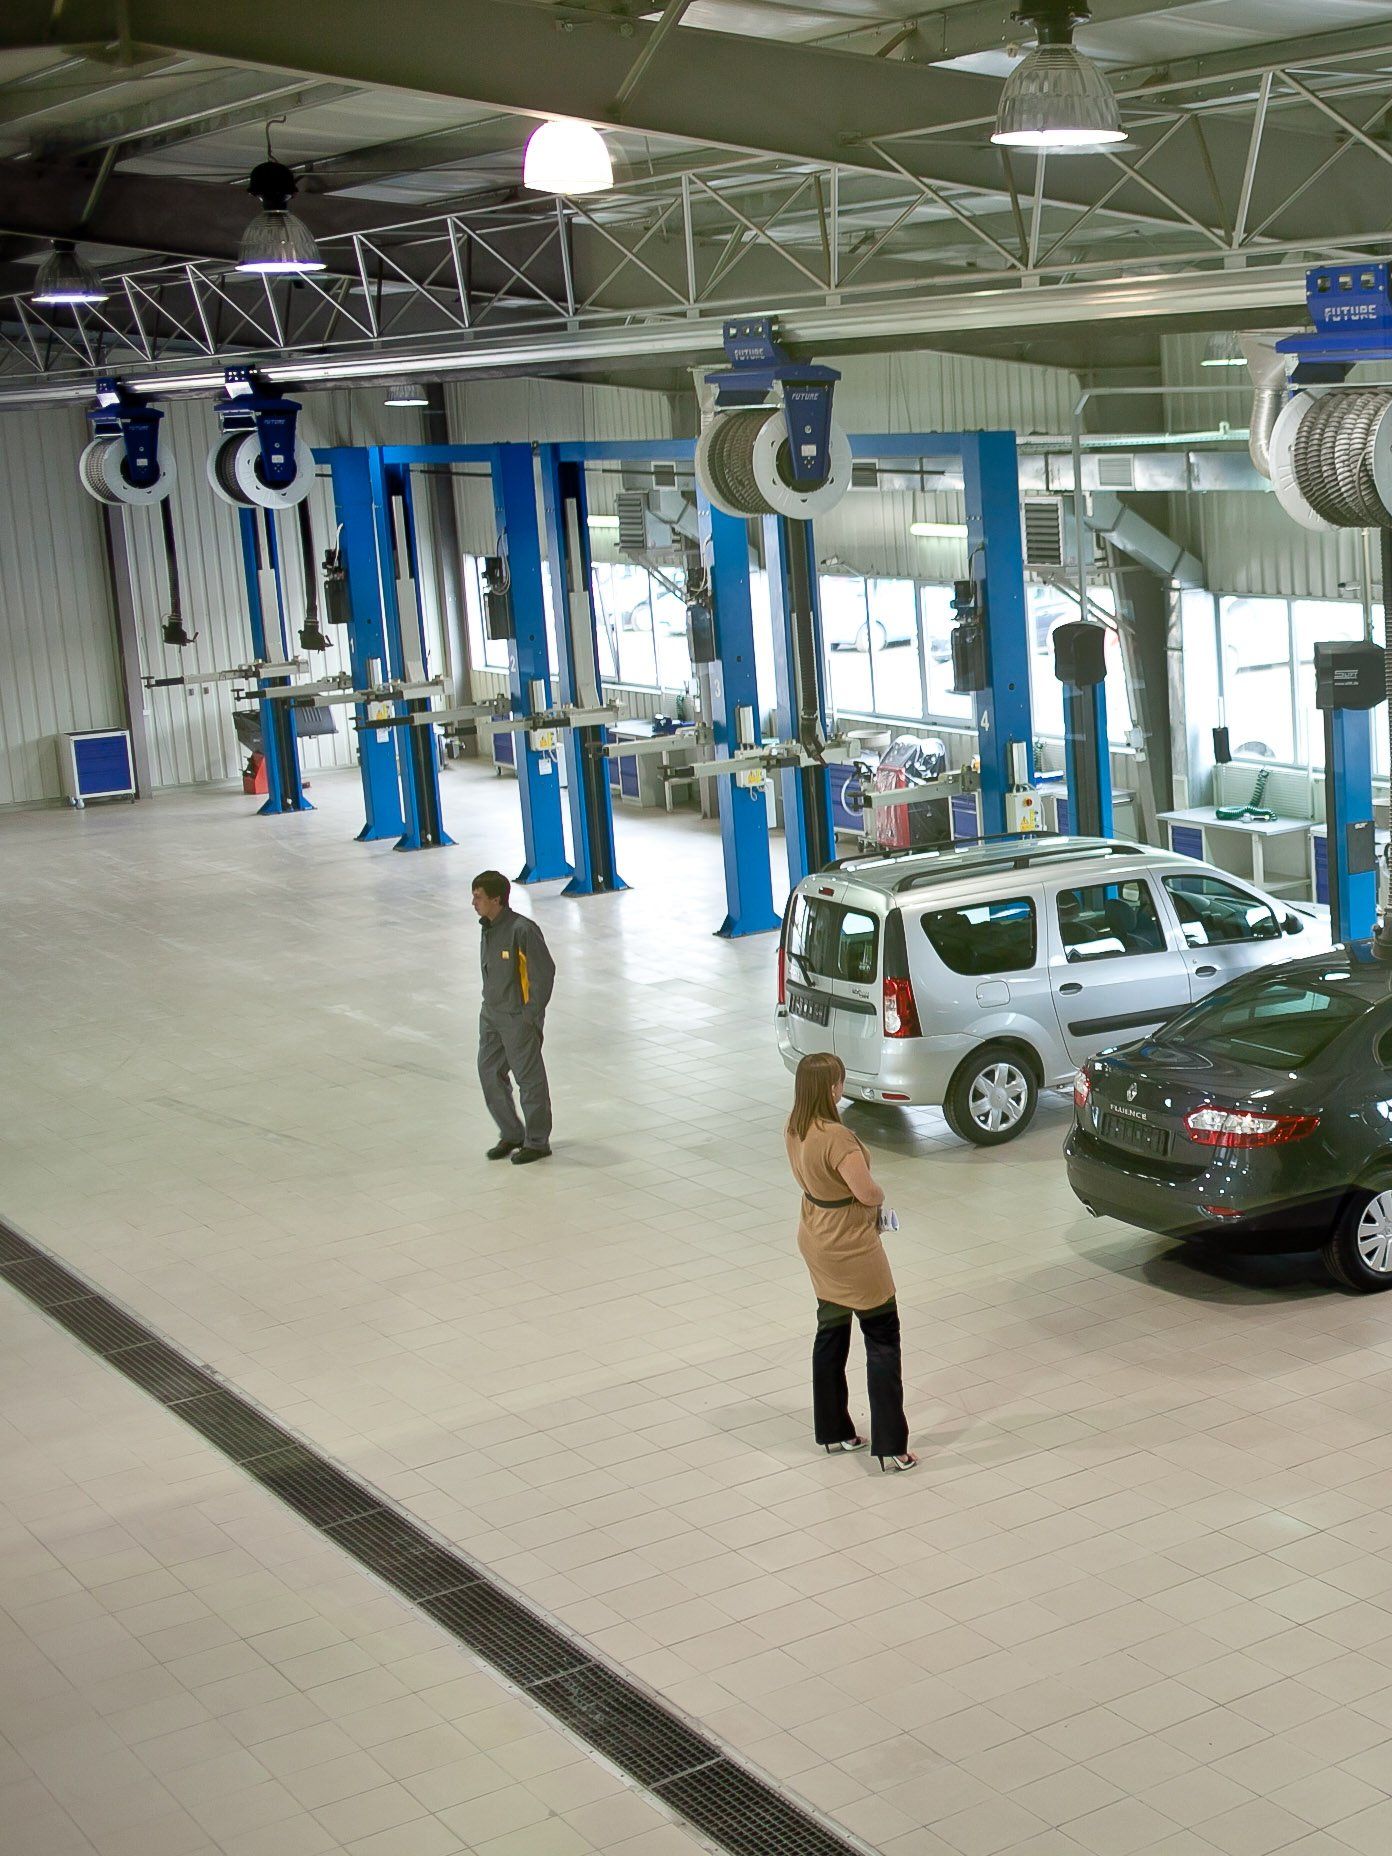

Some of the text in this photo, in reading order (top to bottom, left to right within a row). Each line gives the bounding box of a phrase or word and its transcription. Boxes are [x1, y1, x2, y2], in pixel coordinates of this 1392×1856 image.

[1324, 304, 1377, 322] FUTURE
[734, 348, 766, 360] FUTURE
[791, 392, 819, 401] FUTURE
[509, 655, 517, 673] 2
[714, 678, 721, 698] 3
[980, 709, 990, 732] 4
[1110, 1103, 1148, 1121] FLUENCE
